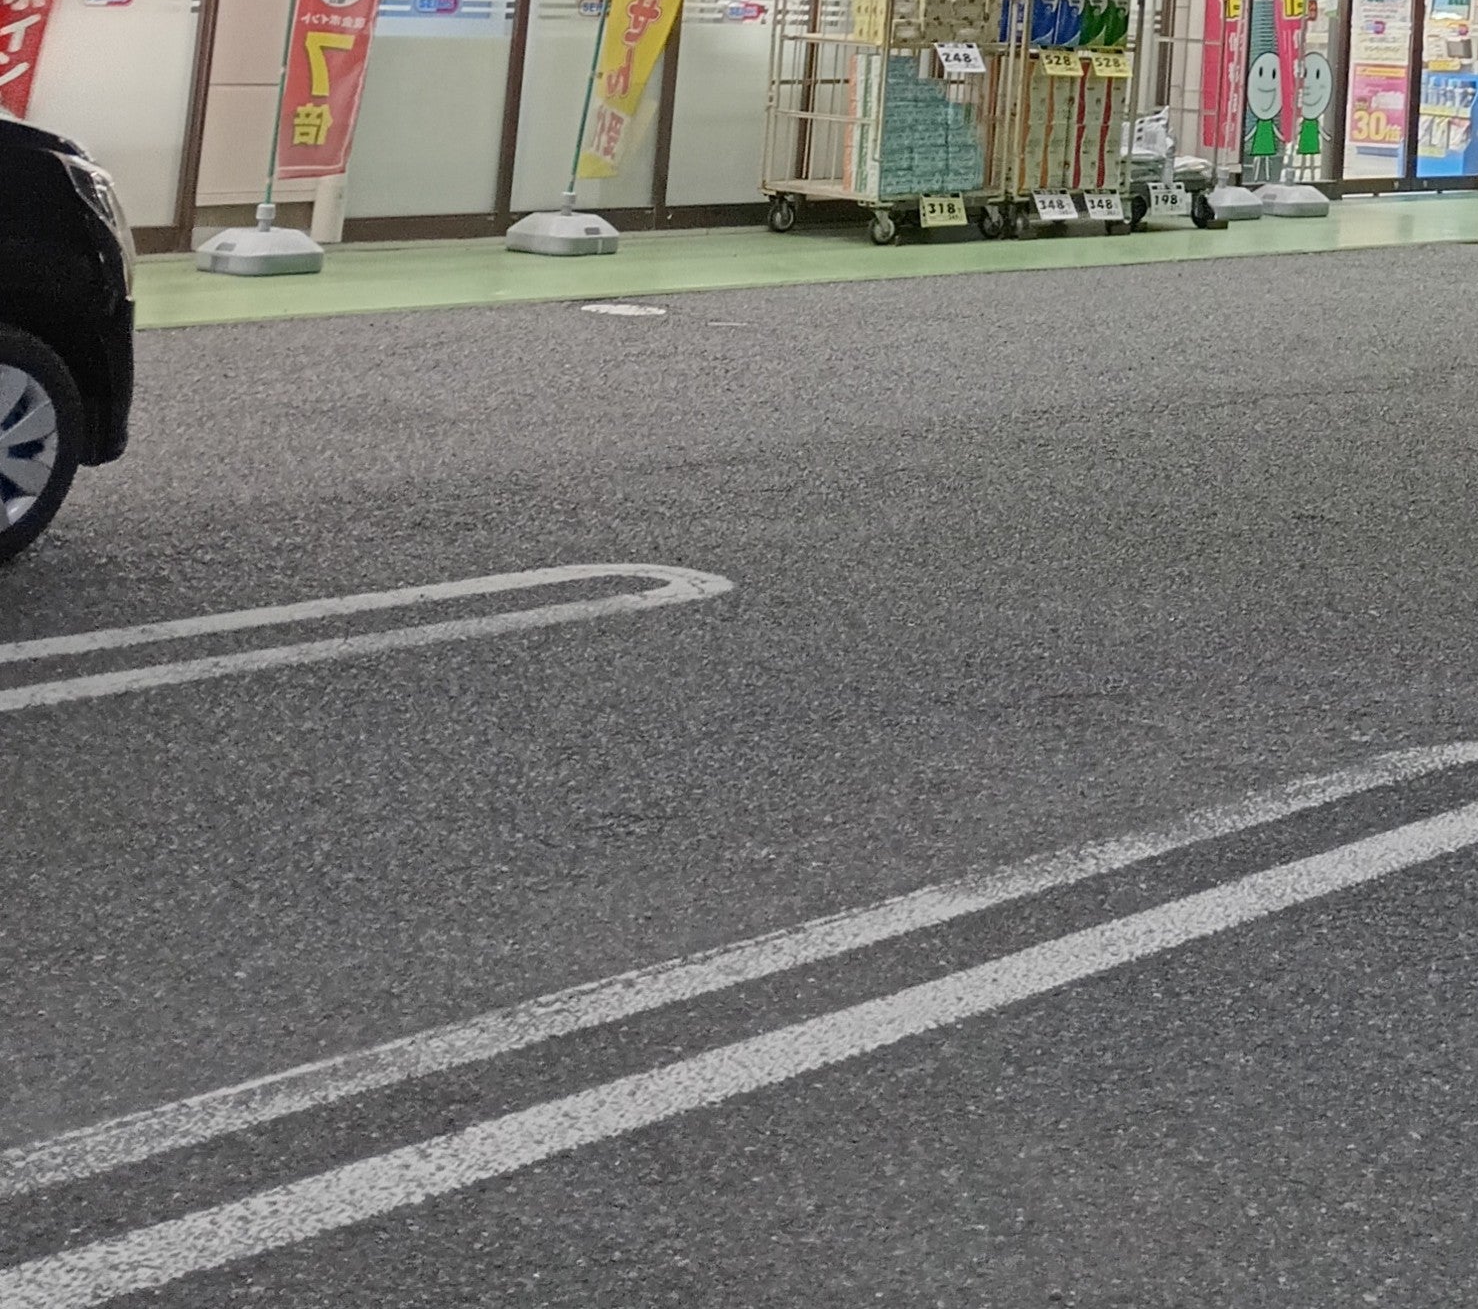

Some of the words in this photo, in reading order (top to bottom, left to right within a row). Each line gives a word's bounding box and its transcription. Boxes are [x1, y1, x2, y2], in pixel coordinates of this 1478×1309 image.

[942, 52, 972, 64] 248
[1044, 53, 1072, 66] 528
[1094, 56, 1121, 68] 528
[1038, 198, 1065, 210] 348
[1088, 198, 1113, 210] 348
[1154, 194, 1178, 206] 198
[928, 202, 956, 214] 318
